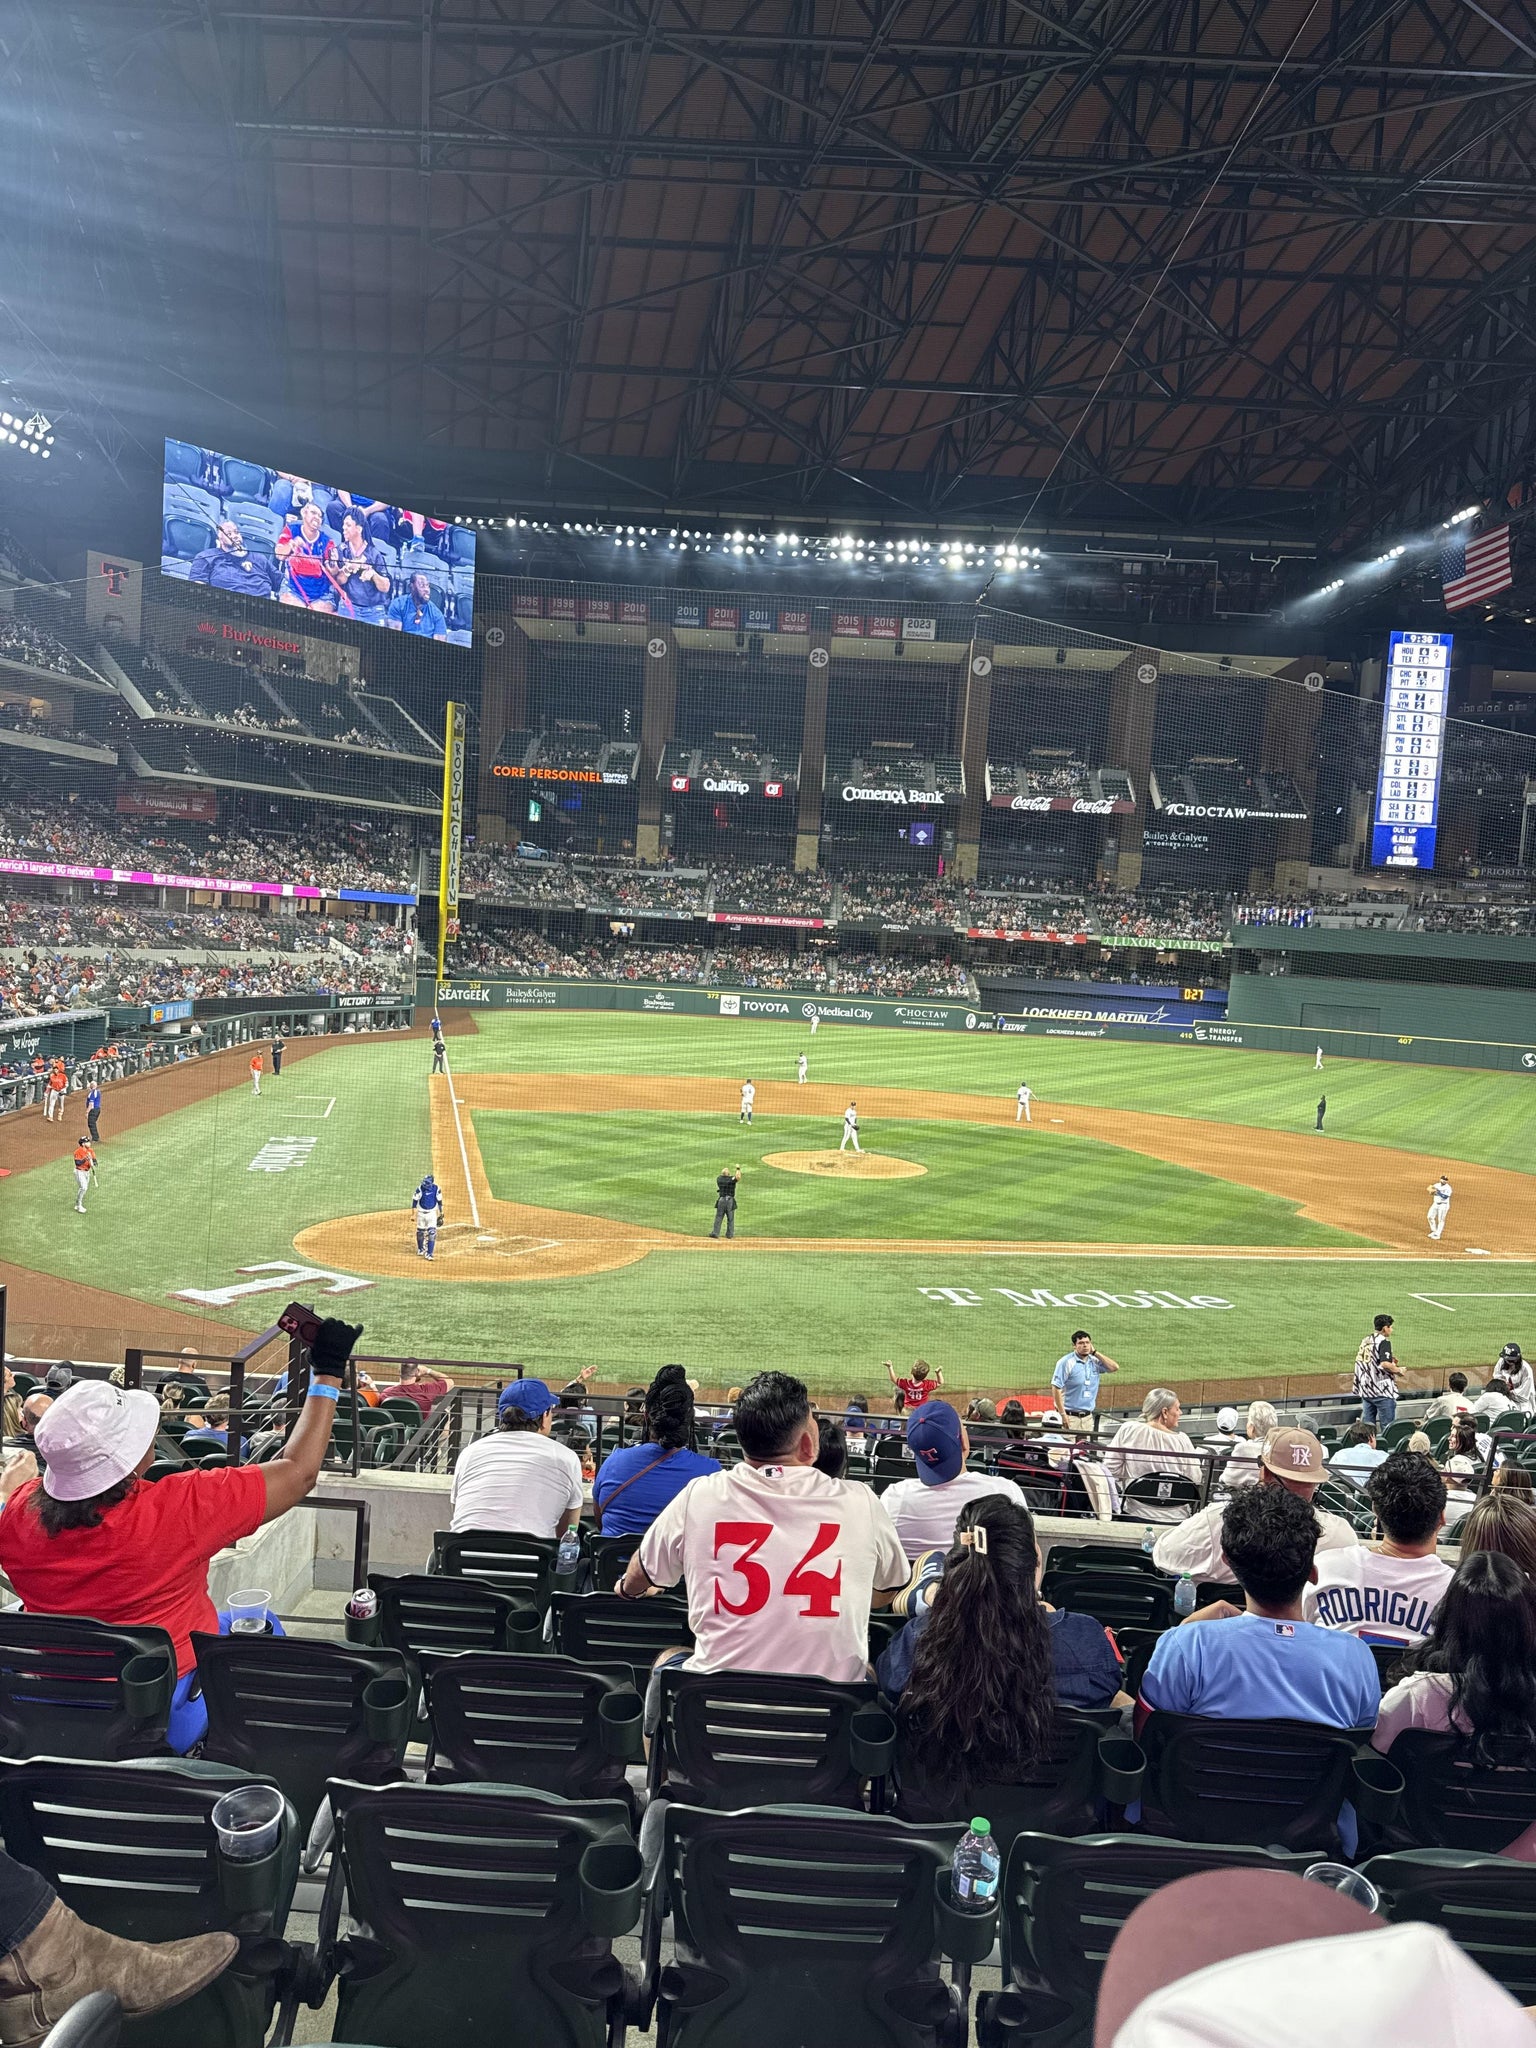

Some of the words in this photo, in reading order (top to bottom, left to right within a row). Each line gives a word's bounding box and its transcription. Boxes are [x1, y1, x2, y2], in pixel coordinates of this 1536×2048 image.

[553, 599, 574, 608] 1998
[588, 601, 609, 610] 1999
[624, 603, 646, 612] 2010
[677, 607, 698, 616] 2010
[714, 609, 734, 618] 2011
[749, 611, 768, 620] 2011
[785, 613, 806, 622] 2012
[838, 616, 859, 625] 2015
[873, 618, 895, 627] 2016
[908, 620, 931, 629] 2023
[222, 624, 299, 653] Budweiser
[488, 631, 502, 643] 42
[649, 642, 664, 654] 34
[812, 652, 827, 663] 26
[978, 661, 986, 670] 7
[1141, 668, 1155, 679] 29
[1308, 676, 1320, 687] 10
[453, 743, 462, 796] ROOT
[493, 765, 526, 777] CORE
[529, 768, 602, 783] PERSONNEL
[602, 772, 629, 780] STAFFING
[672, 778, 688, 790] QT
[703, 778, 750, 795] QuikTrip
[765, 784, 780, 795] QT
[1390, 781, 1401, 789] COL
[908, 789, 945, 804] Bank
[1390, 789, 1401, 797] LAD
[146, 799, 188, 811] FOUNDATION
[452, 803, 460, 817] 4
[1173, 803, 1248, 819] CHOCTAW
[1388, 811, 1399, 819] ATH
[449, 823, 460, 904] CHIKIN
[29, 862, 55, 874] largest
[67, 866, 95, 877] network
[1481, 868, 1528, 876] PRIORITY
[153, 873, 166, 883] Best
[175, 876, 206, 889] coverage
[216, 880, 229, 888] the
[230, 882, 253, 891] game
[638, 910, 663, 918] American
[725, 914, 766, 923] America's
[765, 916, 781, 924] Best
[782, 917, 815, 927] Network
[881, 922, 910, 931] ARENA
[1003, 930, 1023, 938] DEX
[1029, 931, 1050, 939] DEX
[1113, 937, 1157, 948] LUXOR
[1159, 939, 1221, 952] STAFFING
[438, 988, 491, 1002] SEATGEEK
[506, 987, 556, 999] Bailey&Galyen
[1184, 988, 1204, 1001] 0:27
[339, 996, 372, 1007] VICTORY
[643, 998, 675, 1007] Budweiser
[743, 1001, 790, 1014] TOYOTA
[899, 1007, 949, 1019] CHOCTAW
[817, 1006, 854, 1018] Medical
[854, 1008, 874, 1021] City
[1022, 1007, 1092, 1020] LOCKHEED
[1094, 1011, 1148, 1023] MARTIN
[1046, 1028, 1075, 1036] LOCKHEED
[1209, 1027, 1237, 1035] ENERGY
[20, 1032, 41, 1056] Kroger
[1208, 1034, 1243, 1043] TRANSFER
[1398, 1037, 1413, 1045] 407
[989, 1288, 1236, 1310] Mobile
[919, 1447, 939, 1462] T
[714, 1521, 842, 1617] 34
